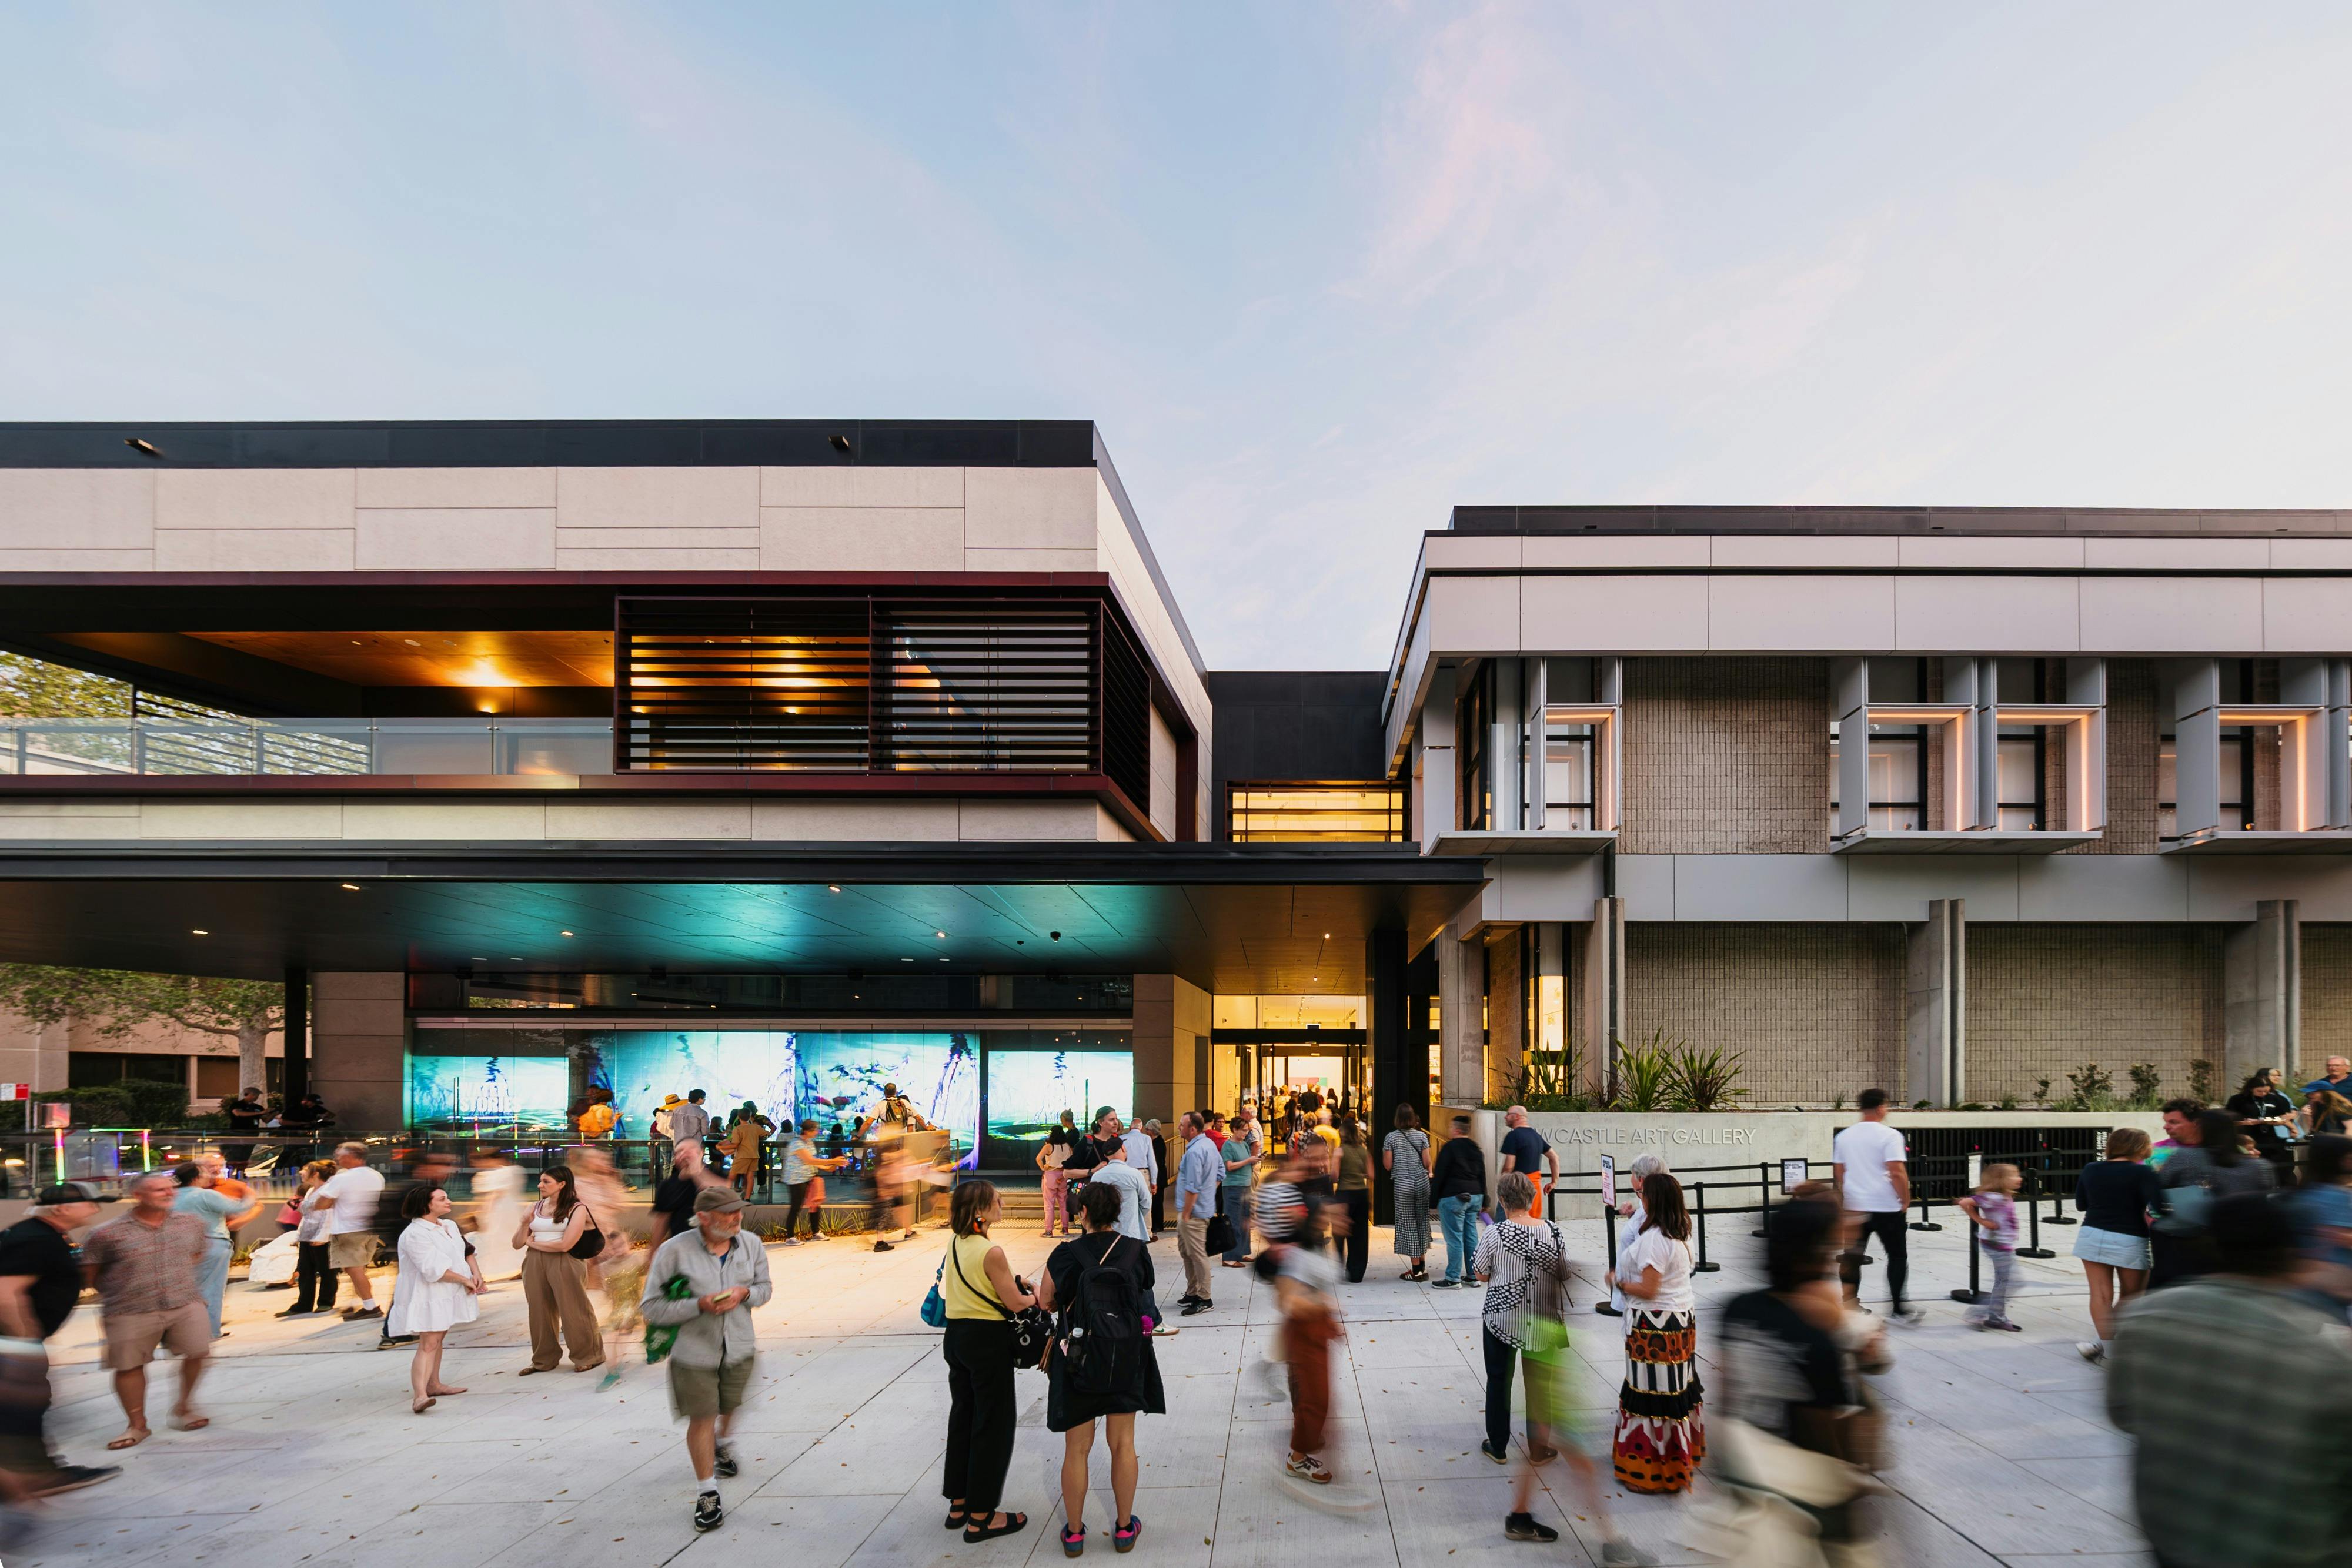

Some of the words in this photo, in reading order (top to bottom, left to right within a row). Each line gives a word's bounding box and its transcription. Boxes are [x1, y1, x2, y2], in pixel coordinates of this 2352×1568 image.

[460, 1096, 522, 1112] STORIES
[1534, 1128, 1627, 1144] WCASTLE
[1631, 1128, 1668, 1144] ART
[1672, 1128, 1757, 1144] GALLERY
